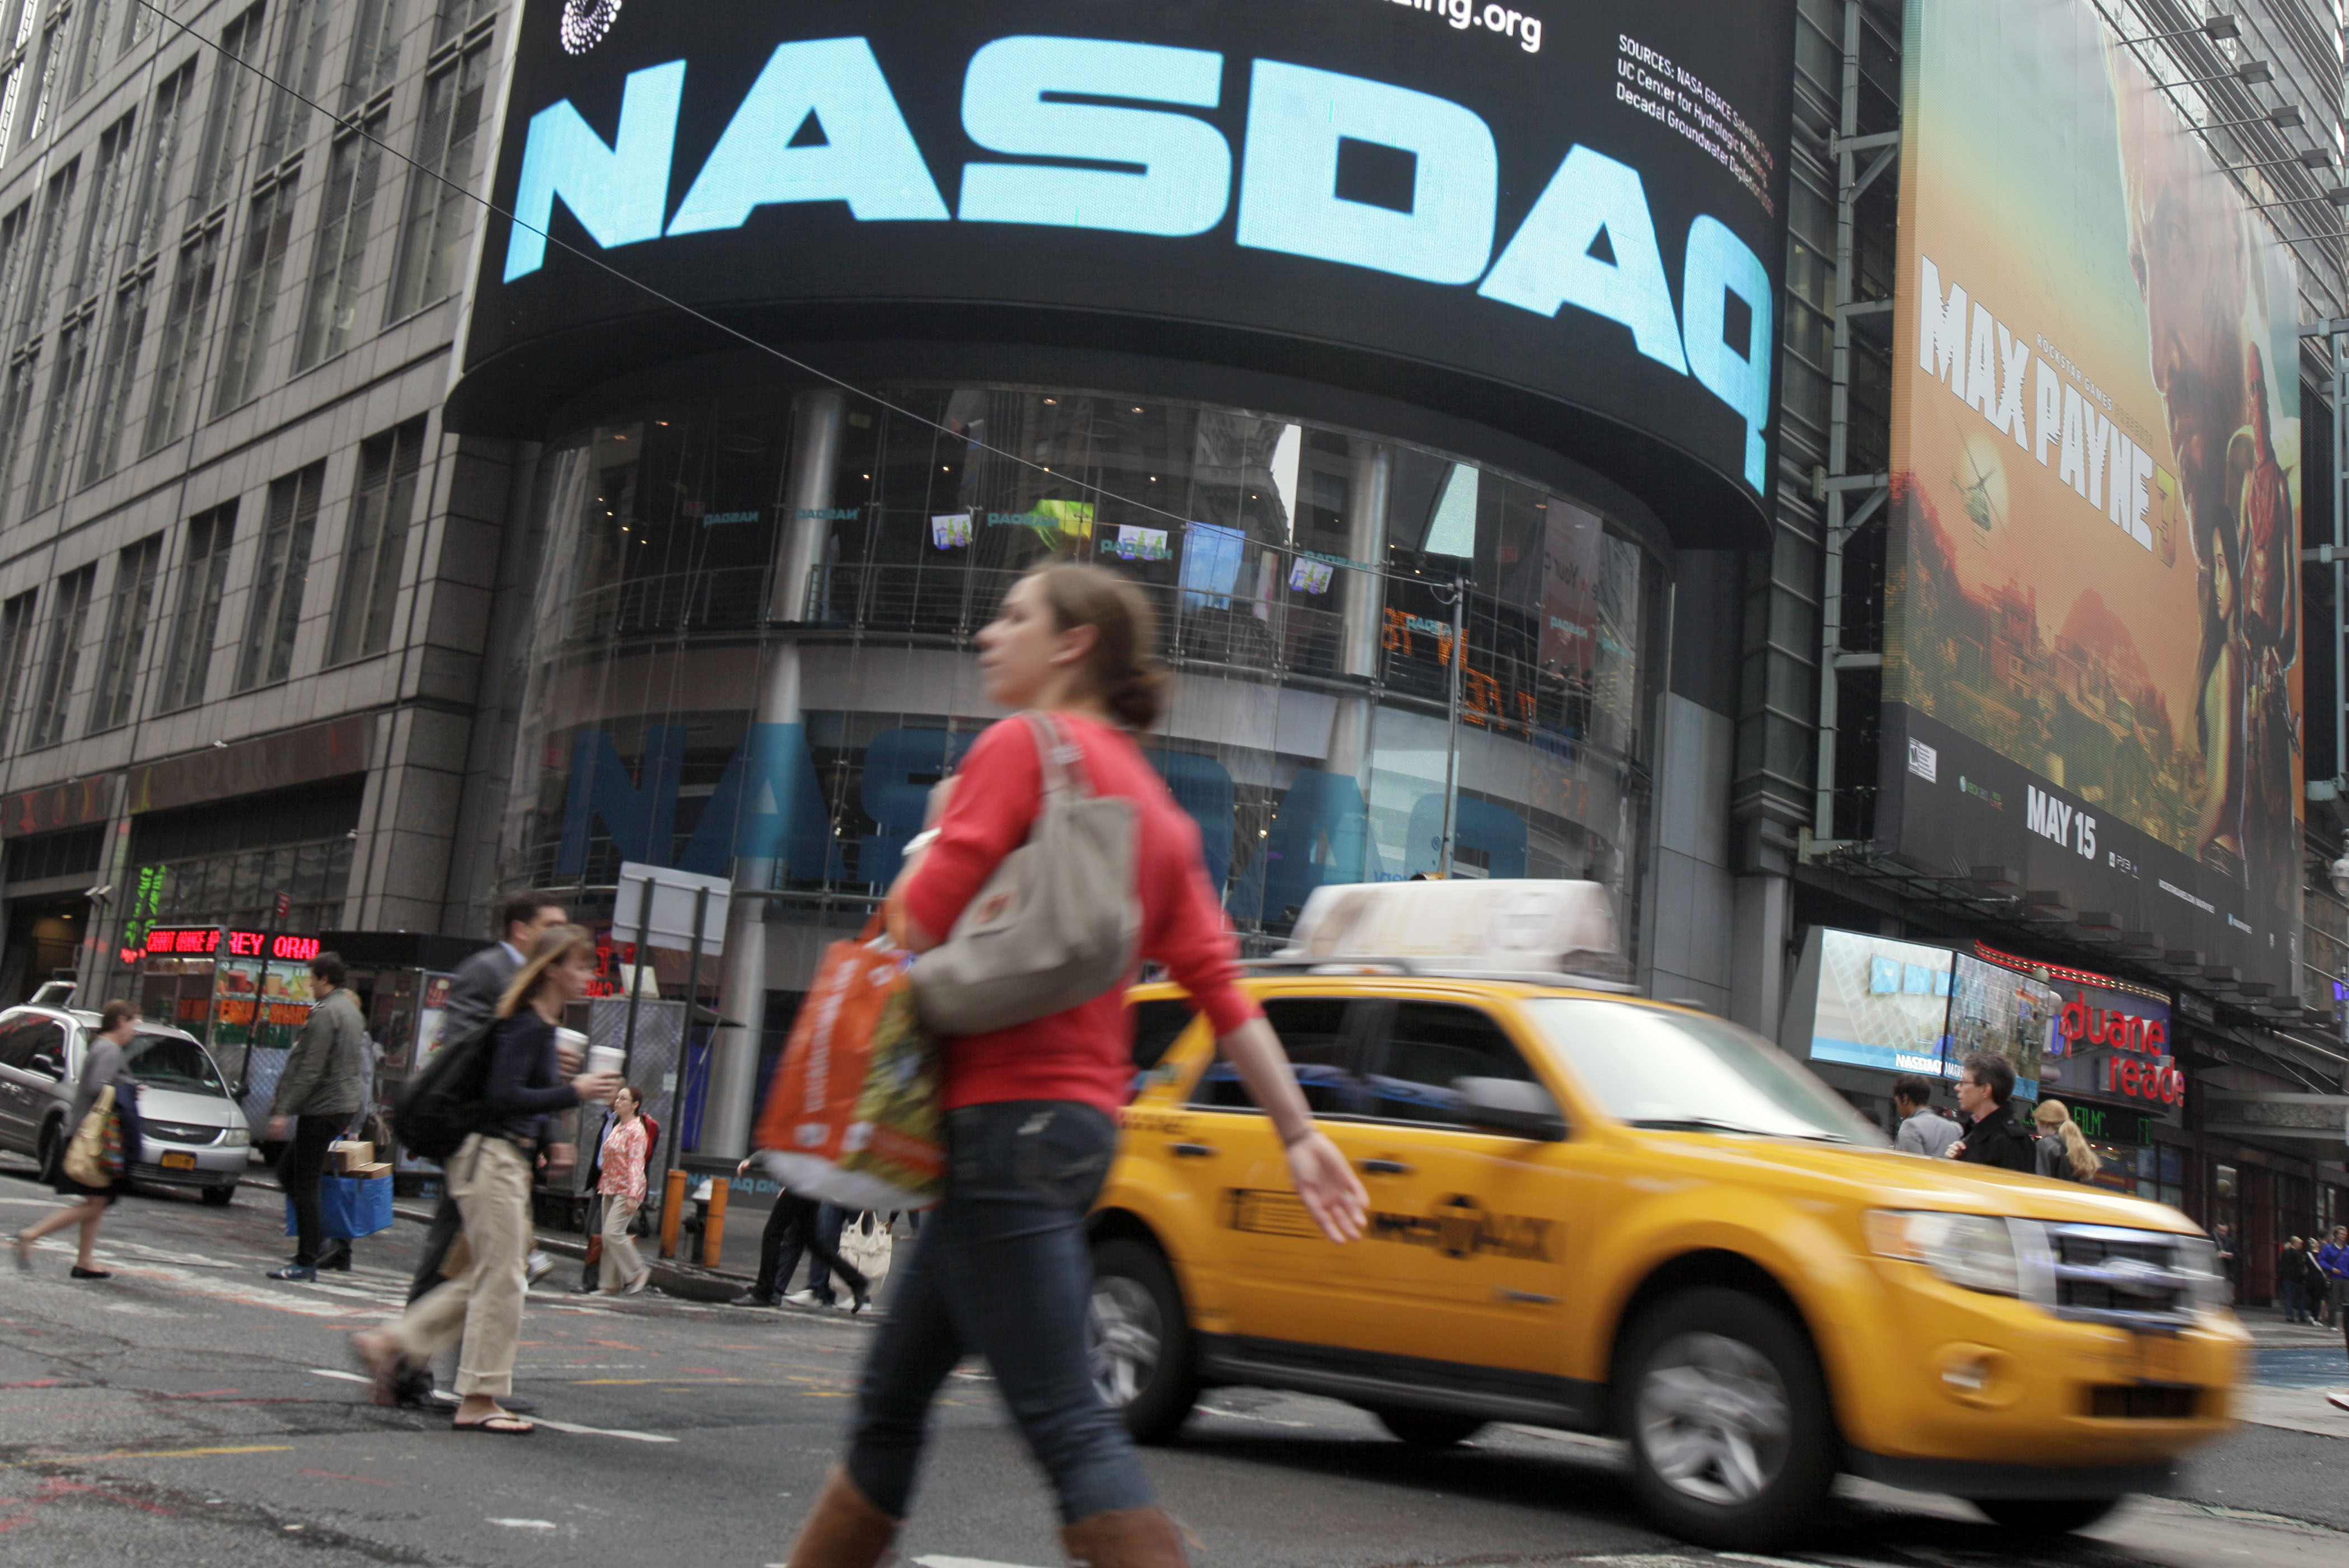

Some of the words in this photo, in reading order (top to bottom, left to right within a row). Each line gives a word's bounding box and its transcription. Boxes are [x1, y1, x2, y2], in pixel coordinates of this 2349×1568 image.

[1617, 58, 1635, 81] UC
[1637, 68, 1676, 102] Center
[1677, 91, 1692, 114] for
[1694, 102, 1739, 153] Hydrologic
[1619, 34, 1674, 79] SOURCES:
[1677, 65, 1704, 100] NASA
[1704, 86, 1732, 122] GRACE
[1617, 81, 1666, 123] Decadal
[1667, 109, 1729, 167] Groundwater
[503, 35, 1774, 497] NASDAQ
[1919, 255, 2031, 452] MAX
[2036, 355, 2154, 553] PAYNE
[2037, 332, 2082, 385] ROCKSTAR
[2085, 376, 2113, 412] GAMES
[2027, 784, 2072, 848] MAY
[2075, 812, 2097, 861] 15
[2061, 990, 2165, 1056] duane
[2109, 1055, 2186, 1107] reade
[687, 1173, 755, 1196] NAAQ
